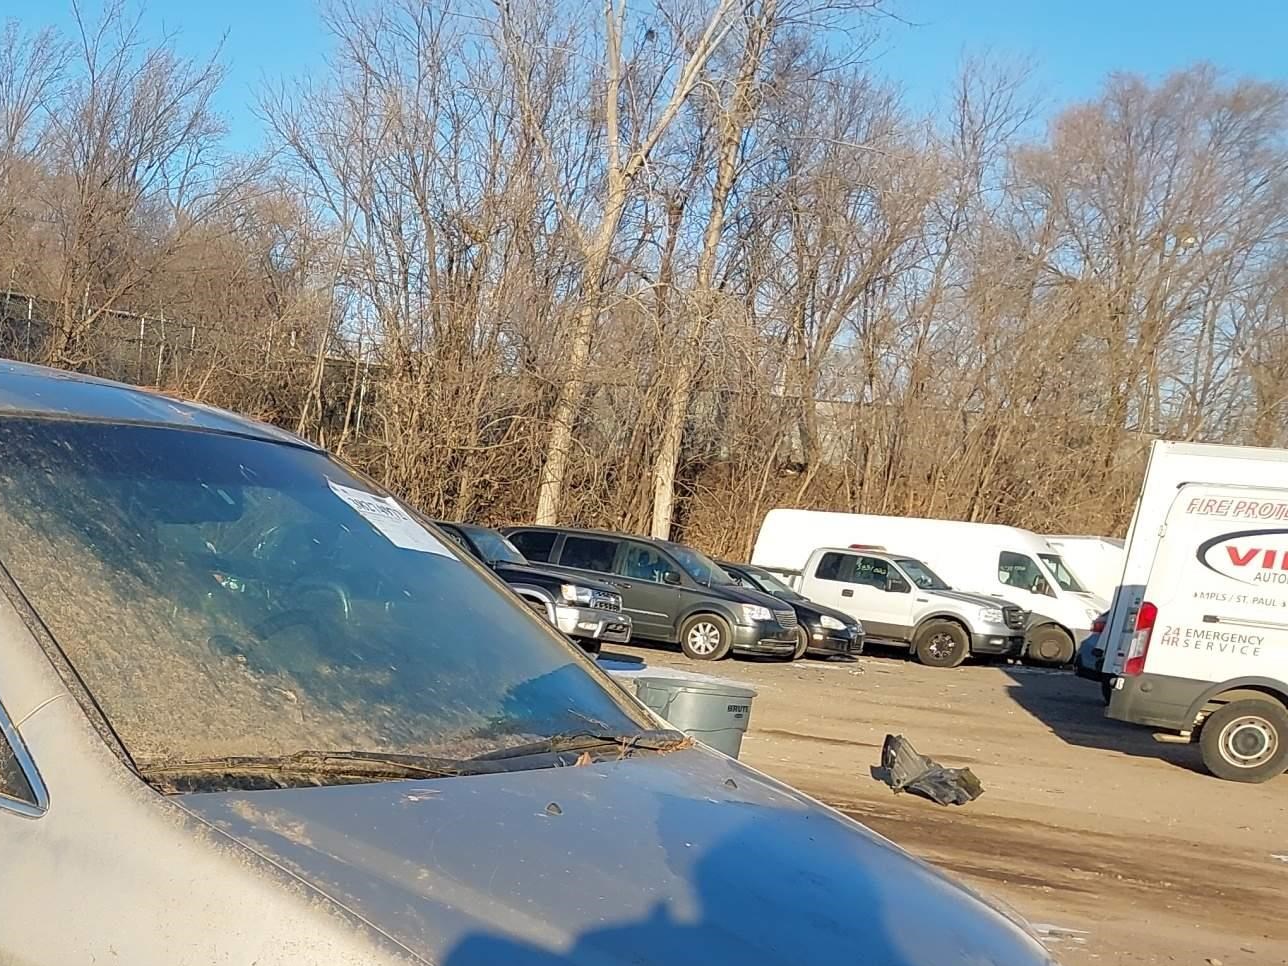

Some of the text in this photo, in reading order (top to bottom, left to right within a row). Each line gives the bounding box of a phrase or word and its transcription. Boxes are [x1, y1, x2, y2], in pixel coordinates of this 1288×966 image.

[1186, 498, 1233, 516] FIRE
[1225, 545, 1288, 571] VI
[1253, 572, 1288, 585] AUTO
[1252, 596, 1278, 607] PAUL
[1161, 635, 1180, 647] HR
[1163, 625, 1264, 646] 24 EMERGENCY
